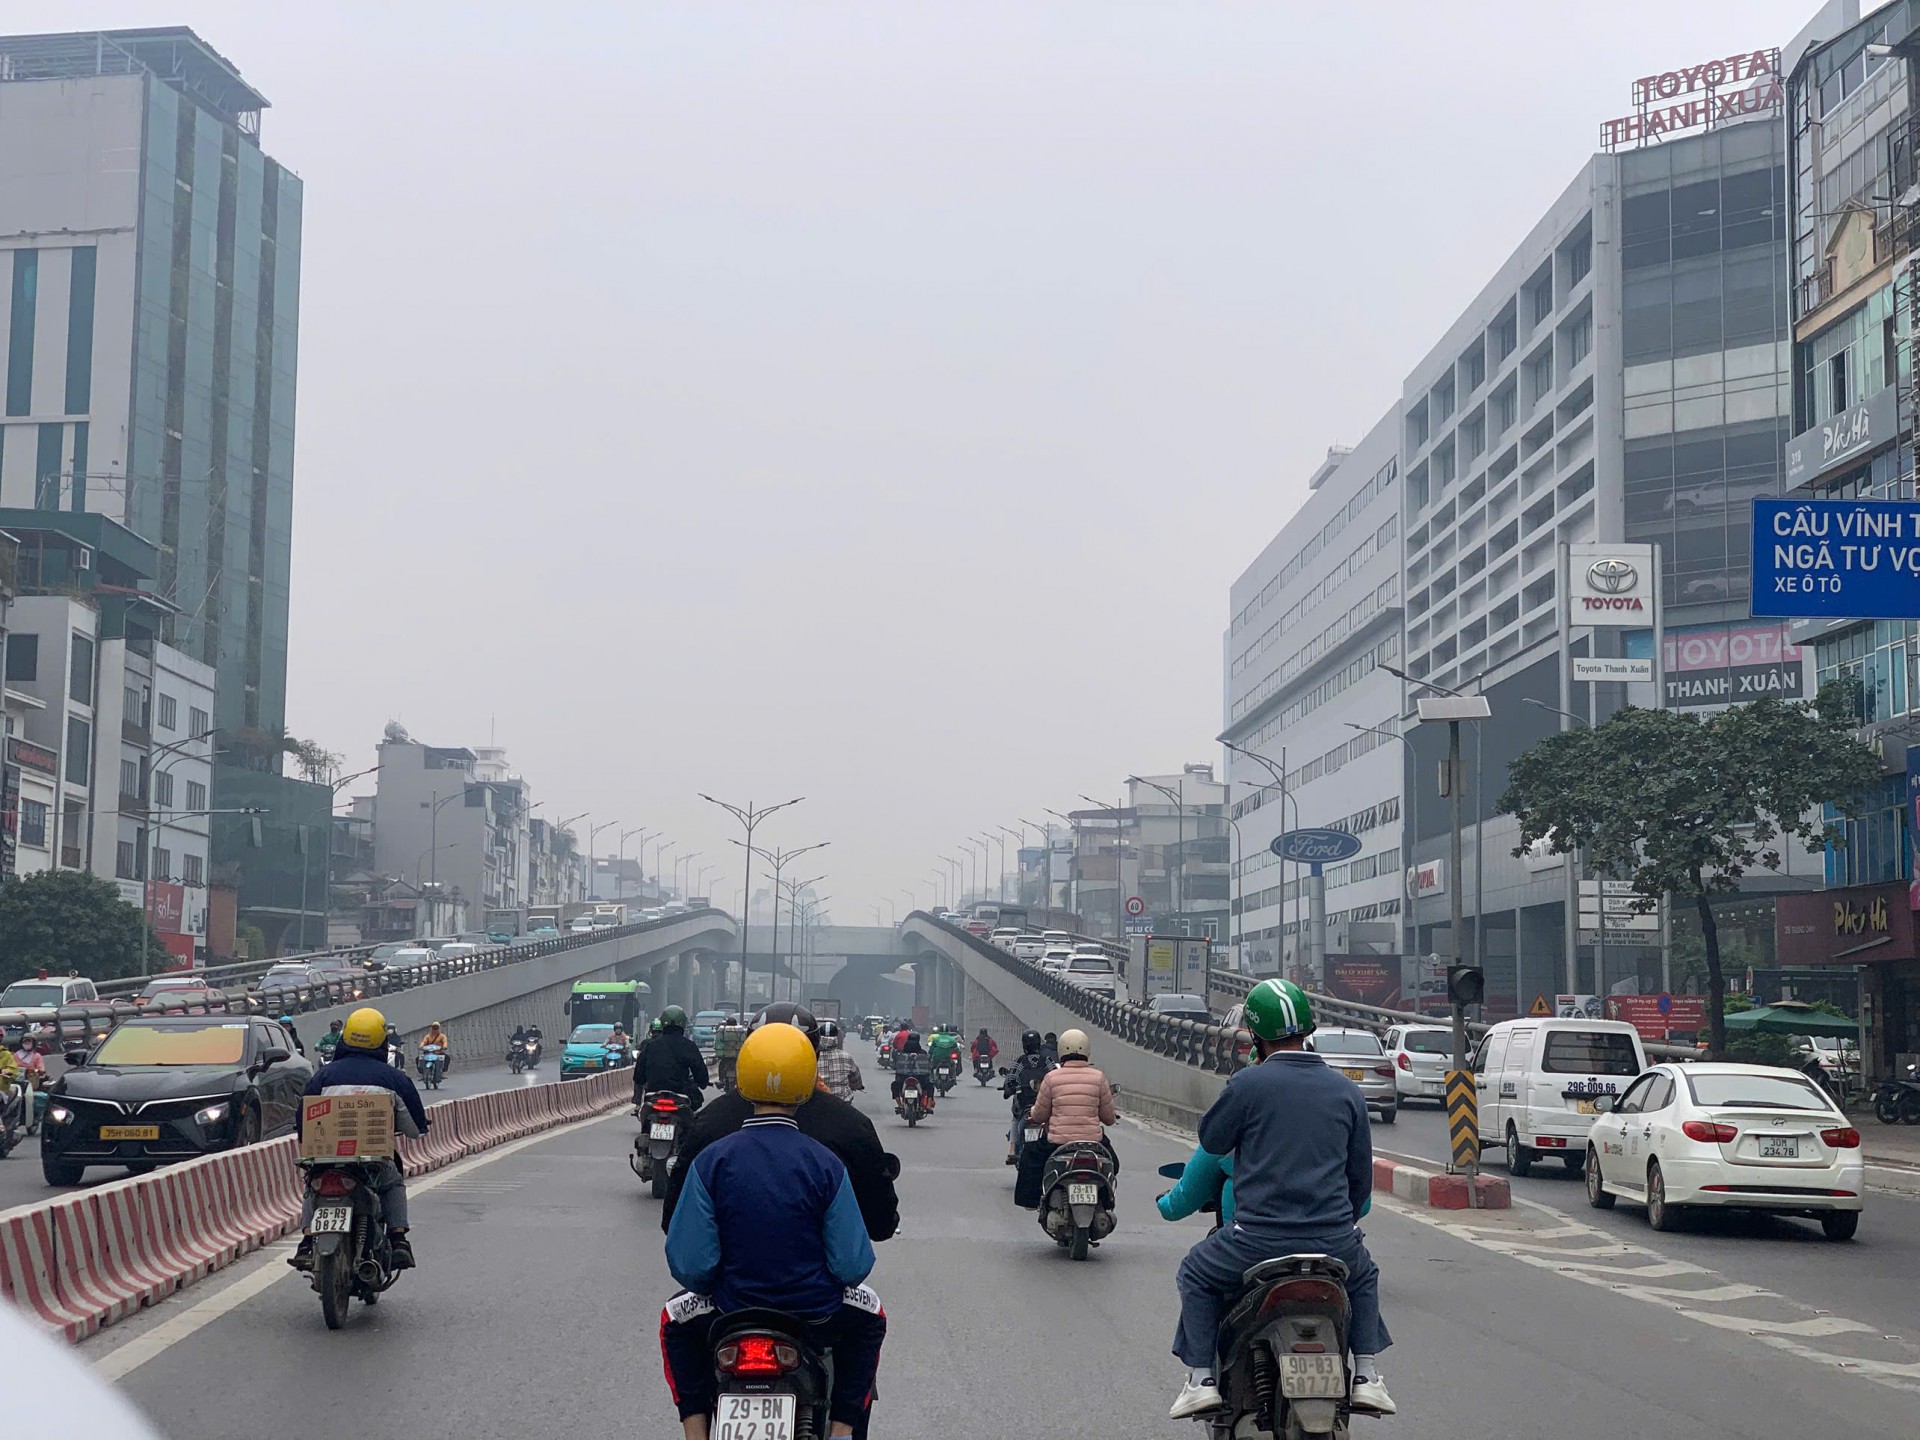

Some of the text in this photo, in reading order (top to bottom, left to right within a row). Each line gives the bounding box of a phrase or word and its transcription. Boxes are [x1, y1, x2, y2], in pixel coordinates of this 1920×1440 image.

[1637, 50, 1771, 103] TOYOTA
[1605, 74, 1785, 145] THANH XUÂ
[1774, 505, 1829, 536] CẦU
[1836, 507, 1901, 537] VĨNH
[1775, 540, 1834, 569] NGÃ
[1840, 544, 1881, 571] TƯ
[1775, 573, 1842, 592] XE Ô TÔ
[1583, 597, 1643, 610] TOYOTA
[1663, 631, 1797, 667] TOYOTA
[1576, 664, 1649, 674] Toyota Thanh Xuân
[1667, 669, 1796, 698] THANH XUÂN
[1288, 834, 1343, 856] Ford
[310, 1103, 328, 1117] Gift
[338, 1099, 375, 1109] Lau Sàn
[729, 1399, 783, 1420] 29-BN
